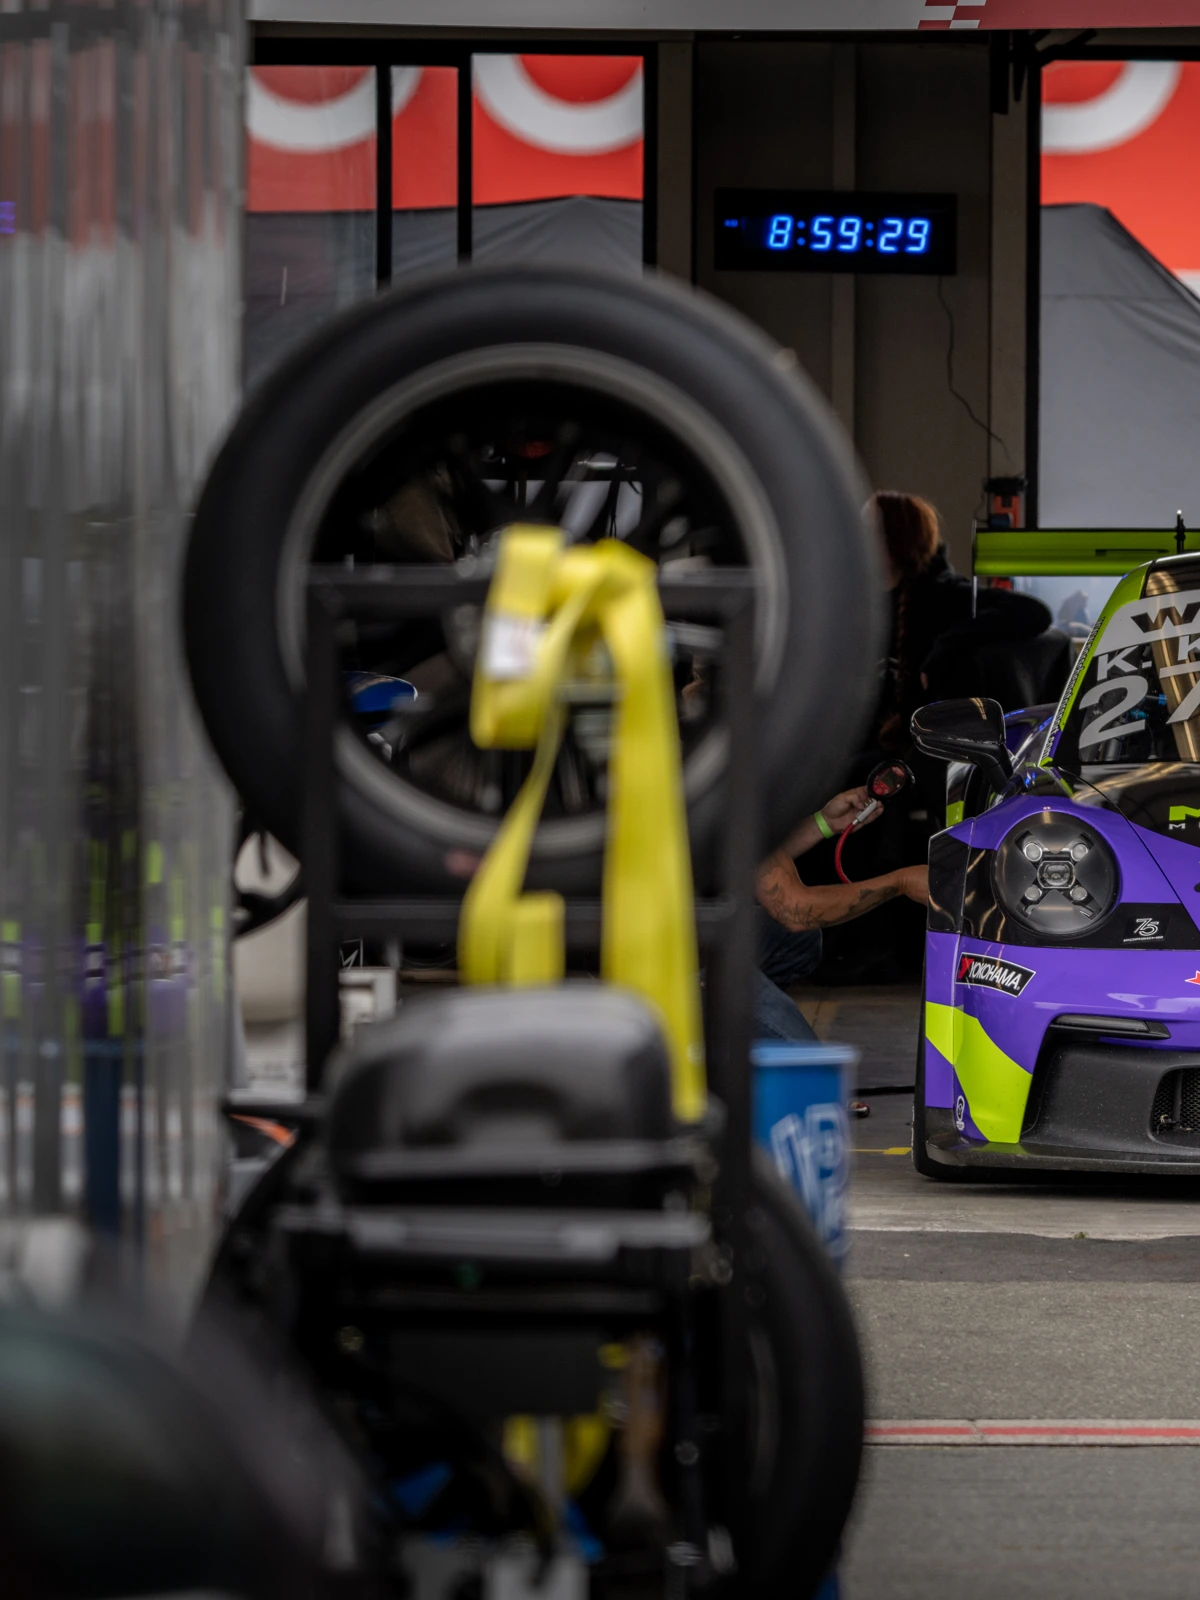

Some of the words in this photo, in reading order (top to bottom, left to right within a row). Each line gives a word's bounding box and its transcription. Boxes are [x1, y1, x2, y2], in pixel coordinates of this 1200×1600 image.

[767, 214, 931, 252] 8:59:29
[1097, 645, 1152, 681] K.
[1133, 917, 1160, 937] 75
[967, 960, 1021, 991] YOKOHAMA
